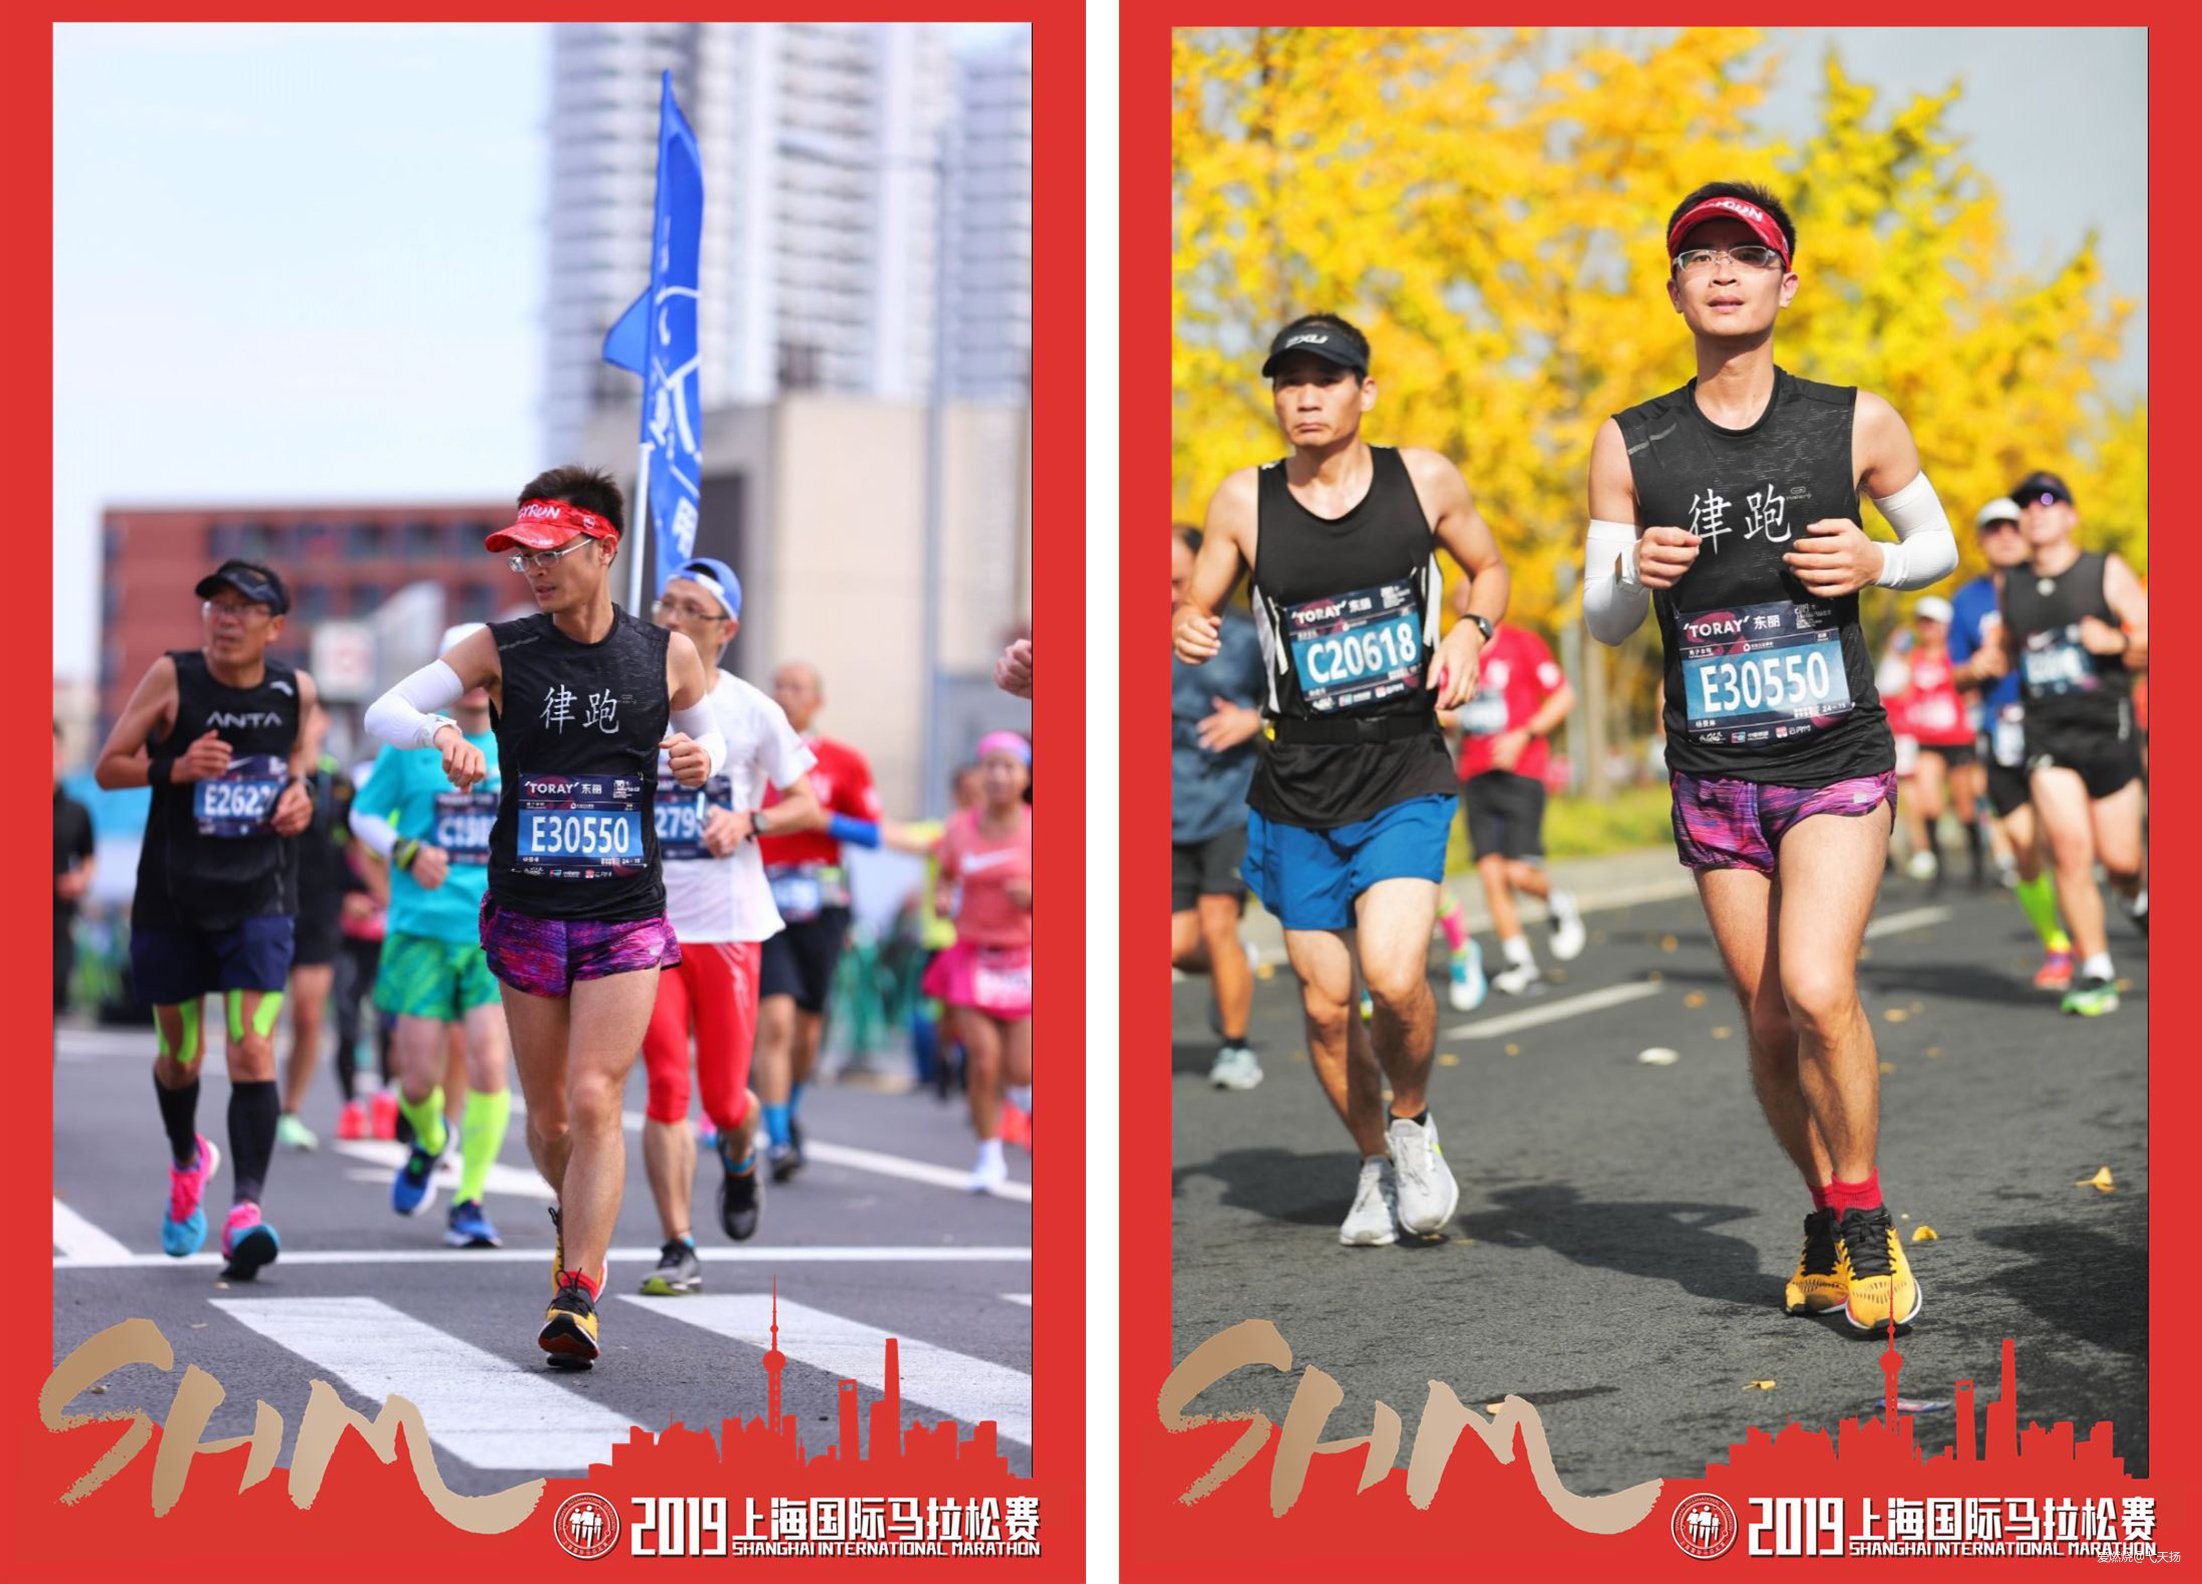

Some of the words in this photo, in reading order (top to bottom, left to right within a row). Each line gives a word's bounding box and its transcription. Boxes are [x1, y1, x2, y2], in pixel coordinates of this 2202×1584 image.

[1688, 483, 1792, 554] 律跑
[1753, 614, 1781, 631] 东丽
[1306, 622, 1417, 683] C20618
[1700, 651, 1830, 713] E30550
[206, 711, 282, 728] ANTA
[539, 683, 620, 735] 律跑
[581, 783, 602, 795] 东丽
[531, 815, 629, 853] E30550
